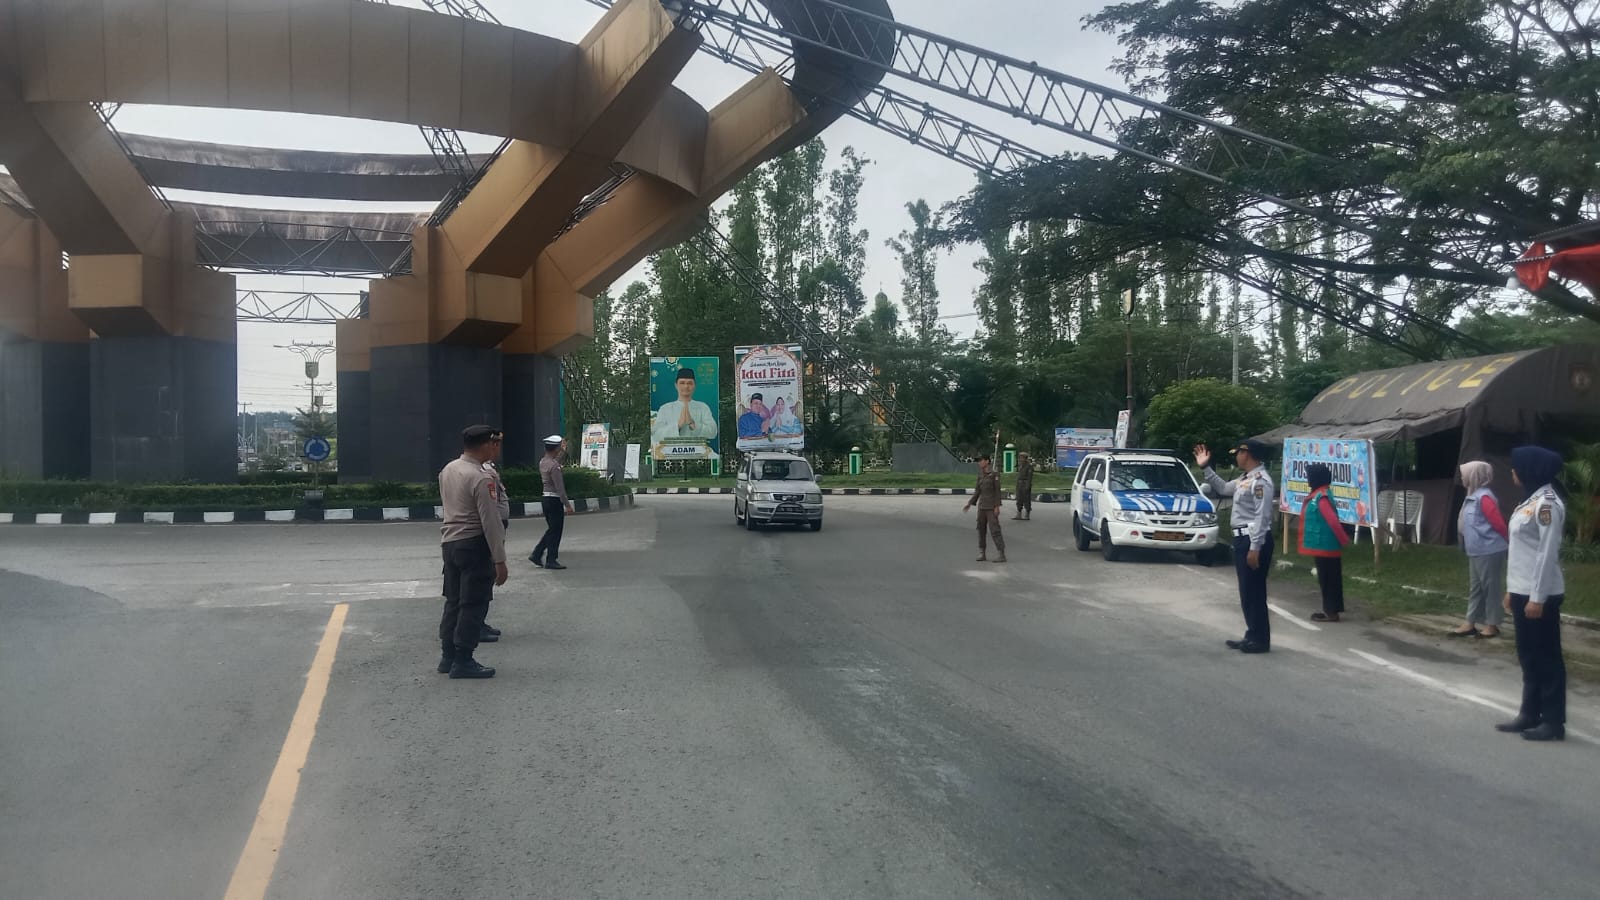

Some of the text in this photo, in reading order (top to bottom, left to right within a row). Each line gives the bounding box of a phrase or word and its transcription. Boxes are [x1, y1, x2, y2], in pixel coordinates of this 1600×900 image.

[741, 367, 795, 380] Idul Fitri
[1317, 356, 1515, 403] POLICE
[1292, 461, 1309, 478] POS
